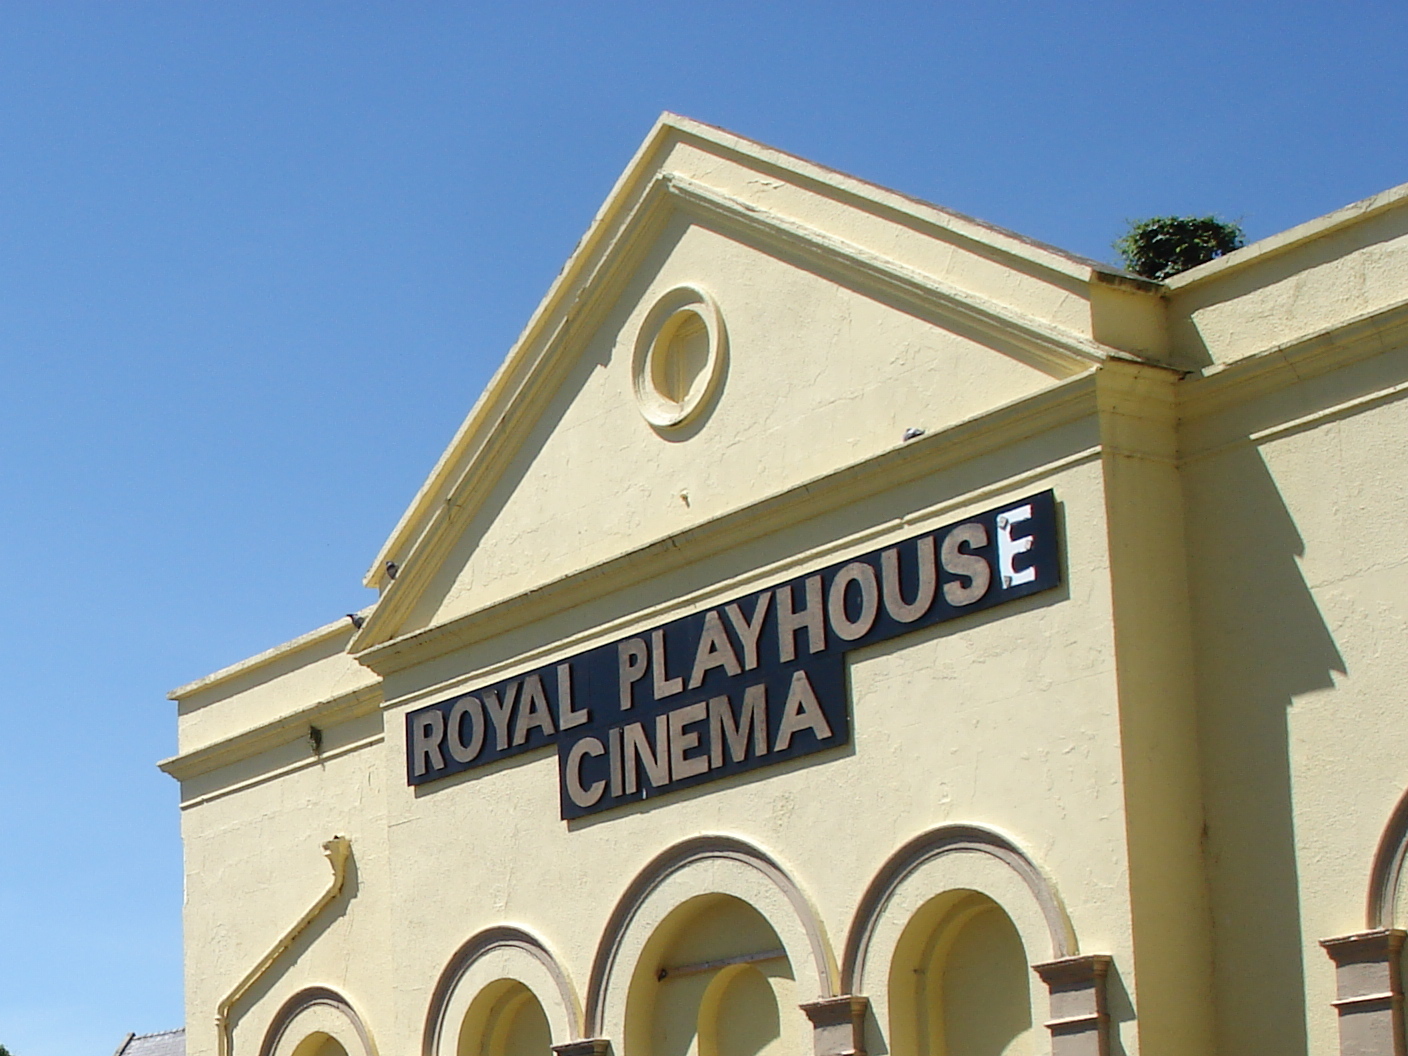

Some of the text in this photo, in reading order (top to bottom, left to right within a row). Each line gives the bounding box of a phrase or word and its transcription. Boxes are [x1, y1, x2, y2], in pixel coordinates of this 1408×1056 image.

[413, 503, 1036, 776] ROYAL PLAYHOUSE
[565, 670, 833, 808] CINEMA
